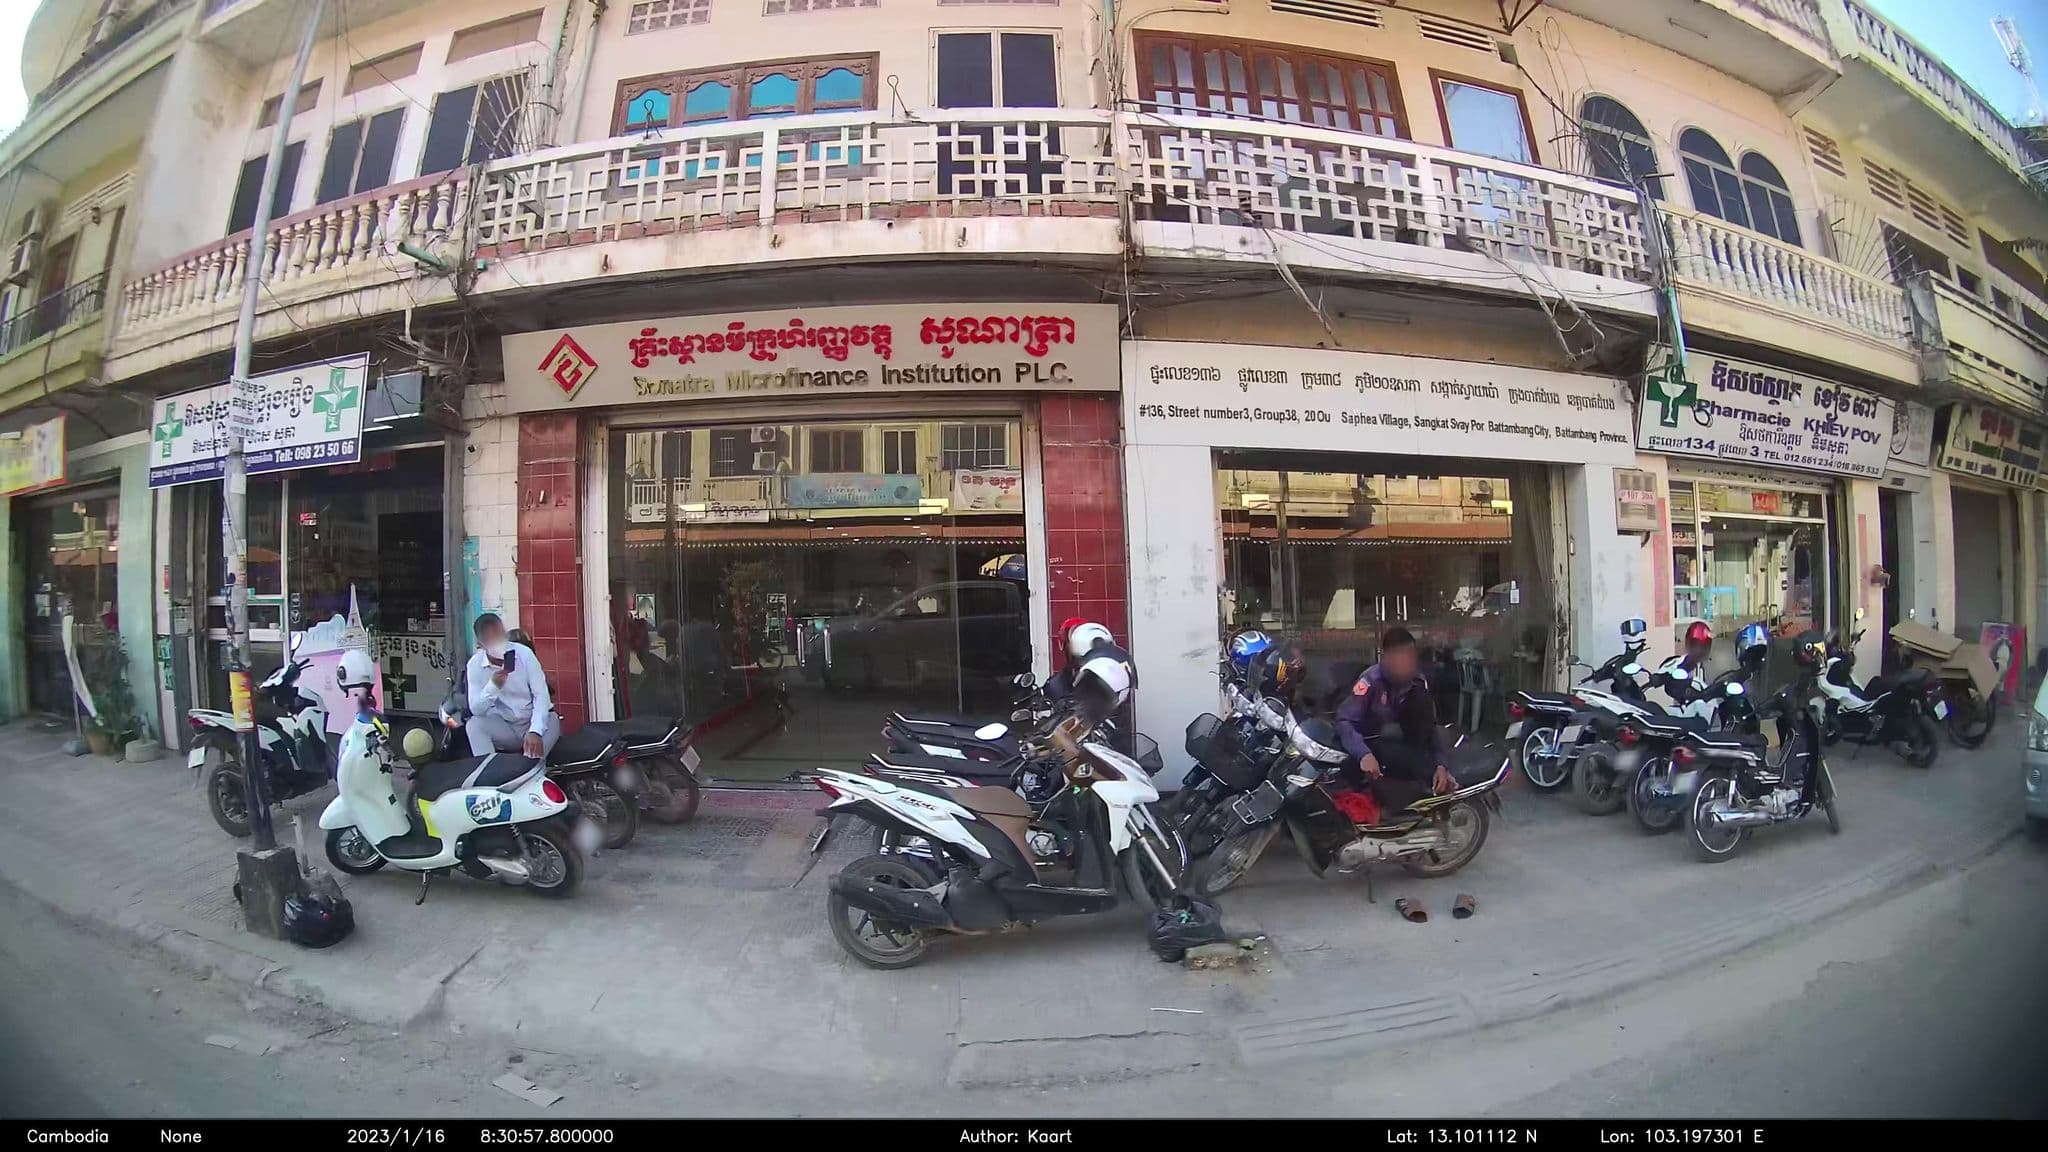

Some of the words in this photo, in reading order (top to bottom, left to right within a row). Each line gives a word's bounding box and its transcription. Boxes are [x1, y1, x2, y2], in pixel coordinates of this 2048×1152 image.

[920, 315, 1075, 358] សូណាត្រា
[726, 366, 869, 391] Microfinance
[882, 363, 1001, 385] Institution
[1015, 362, 1073, 384] PLC.
[1139, 405, 1166, 420] #136,
[1168, 405, 1200, 419] Street
[1341, 412, 1377, 428] Saphea
[1379, 413, 1411, 429] Village,
[1414, 416, 1449, 431] Sangkat
[1450, 418, 1469, 434] Svay
[1471, 420, 1485, 432] Por
[1489, 421, 1534, 438] Battambang
[1534, 425, 1552, 439] City,
[1556, 426, 1597, 443] Battambang
[1697, 399, 1791, 427] Pharmacie
[1804, 417, 1849, 437] KHIEV
[1851, 427, 1881, 444] POV
[313, 444, 326, 459] 23
[327, 442, 340, 457] 50
[341, 440, 355, 455] 66
[1750, 446, 1760, 457] 3
[1764, 450, 1781, 460] TEL
[1784, 453, 1800, 463] 012
